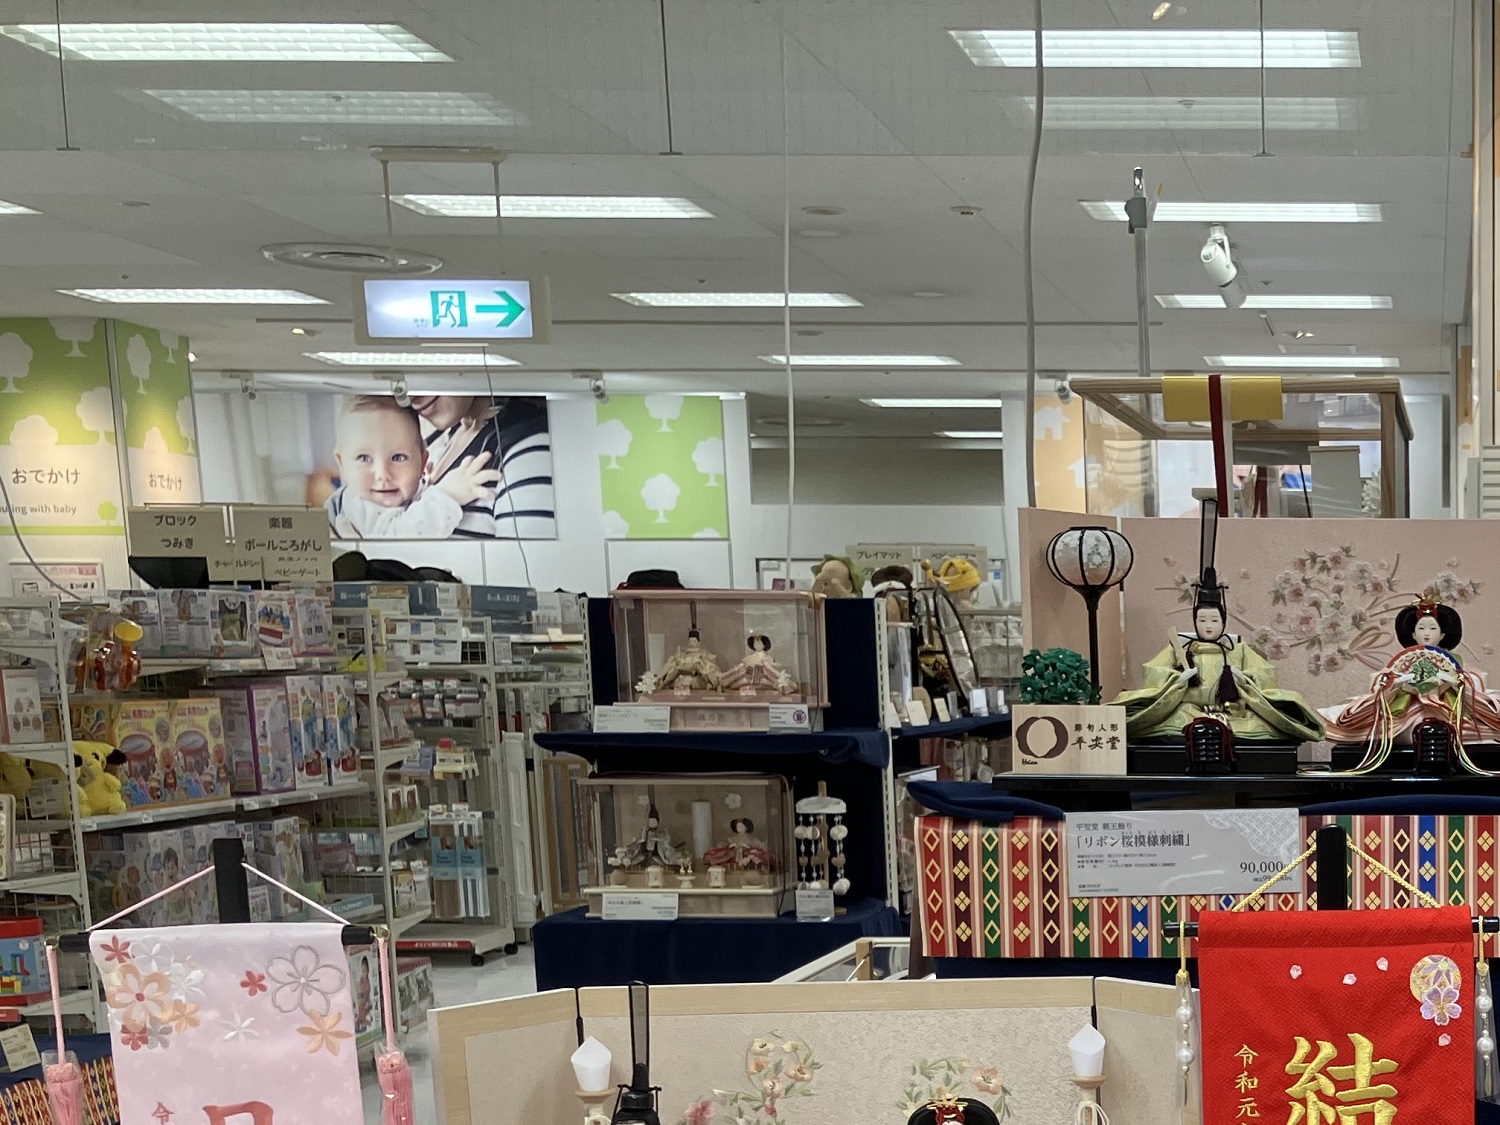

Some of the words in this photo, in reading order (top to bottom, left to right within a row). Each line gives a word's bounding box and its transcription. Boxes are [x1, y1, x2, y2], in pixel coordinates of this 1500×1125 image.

[12, 467, 81, 486] おでかけ
[148, 472, 183, 492] おでかけ
[29, 503, 51, 514] with
[53, 504, 77, 517] baby
[154, 514, 197, 527] ブロック
[268, 517, 294, 530] 楽器
[160, 537, 195, 550] つみき
[244, 538, 323, 552] ボールころがし
[856, 551, 902, 560] プレイマット
[1070, 735, 1121, 750] 平安堂
[1076, 822, 1099, 831] 平安堂
[1102, 822, 1133, 831] 親王飾り
[1076, 833, 1191, 849] 「リボン桜模様刺繍」
[1239, 861, 1290, 875] 90,000
